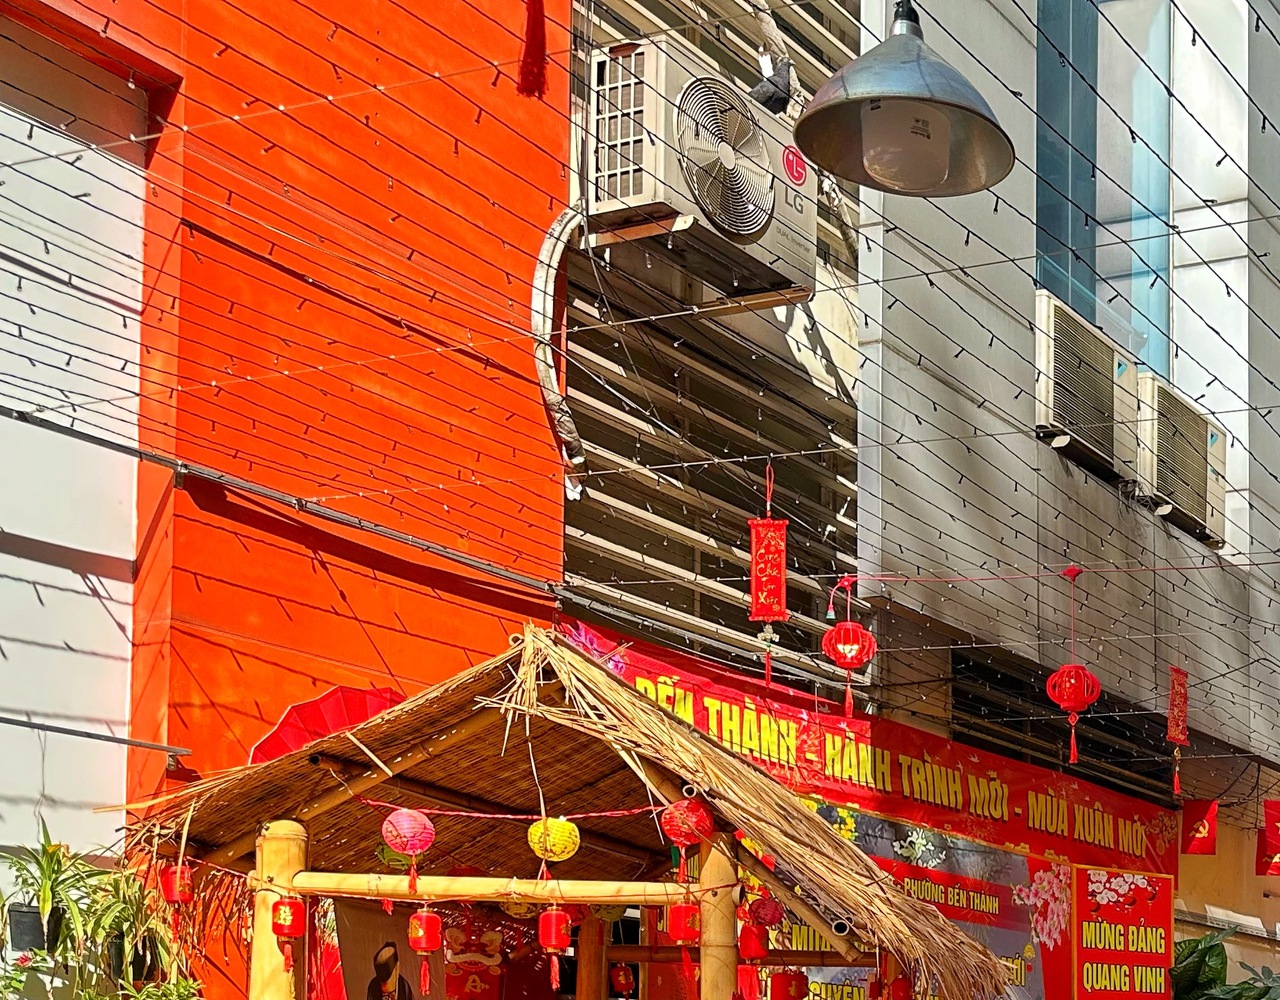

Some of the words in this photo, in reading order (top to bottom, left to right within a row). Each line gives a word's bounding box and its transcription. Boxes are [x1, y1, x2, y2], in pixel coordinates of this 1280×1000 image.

[785, 186, 803, 214] LG
[703, 696, 797, 767] THÀNH
[825, 728, 892, 792] HÀNH
[899, 749, 963, 812] TRÌNH
[968, 769, 1009, 821] MỚI
[1027, 786, 1068, 837] MÙA
[1074, 802, 1114, 848] XUÂN
[1118, 814, 1148, 858] MỚI
[904, 877, 945, 904] PHƯỜNG
[947, 882, 967, 908] BẾN
[968, 890, 999, 915] THÀNH
[1082, 916, 1125, 951] MỪNG
[1128, 917, 1166, 954] ĐẢNG
[1083, 962, 1130, 993] QUANG
[1134, 965, 1166, 994] VINH
